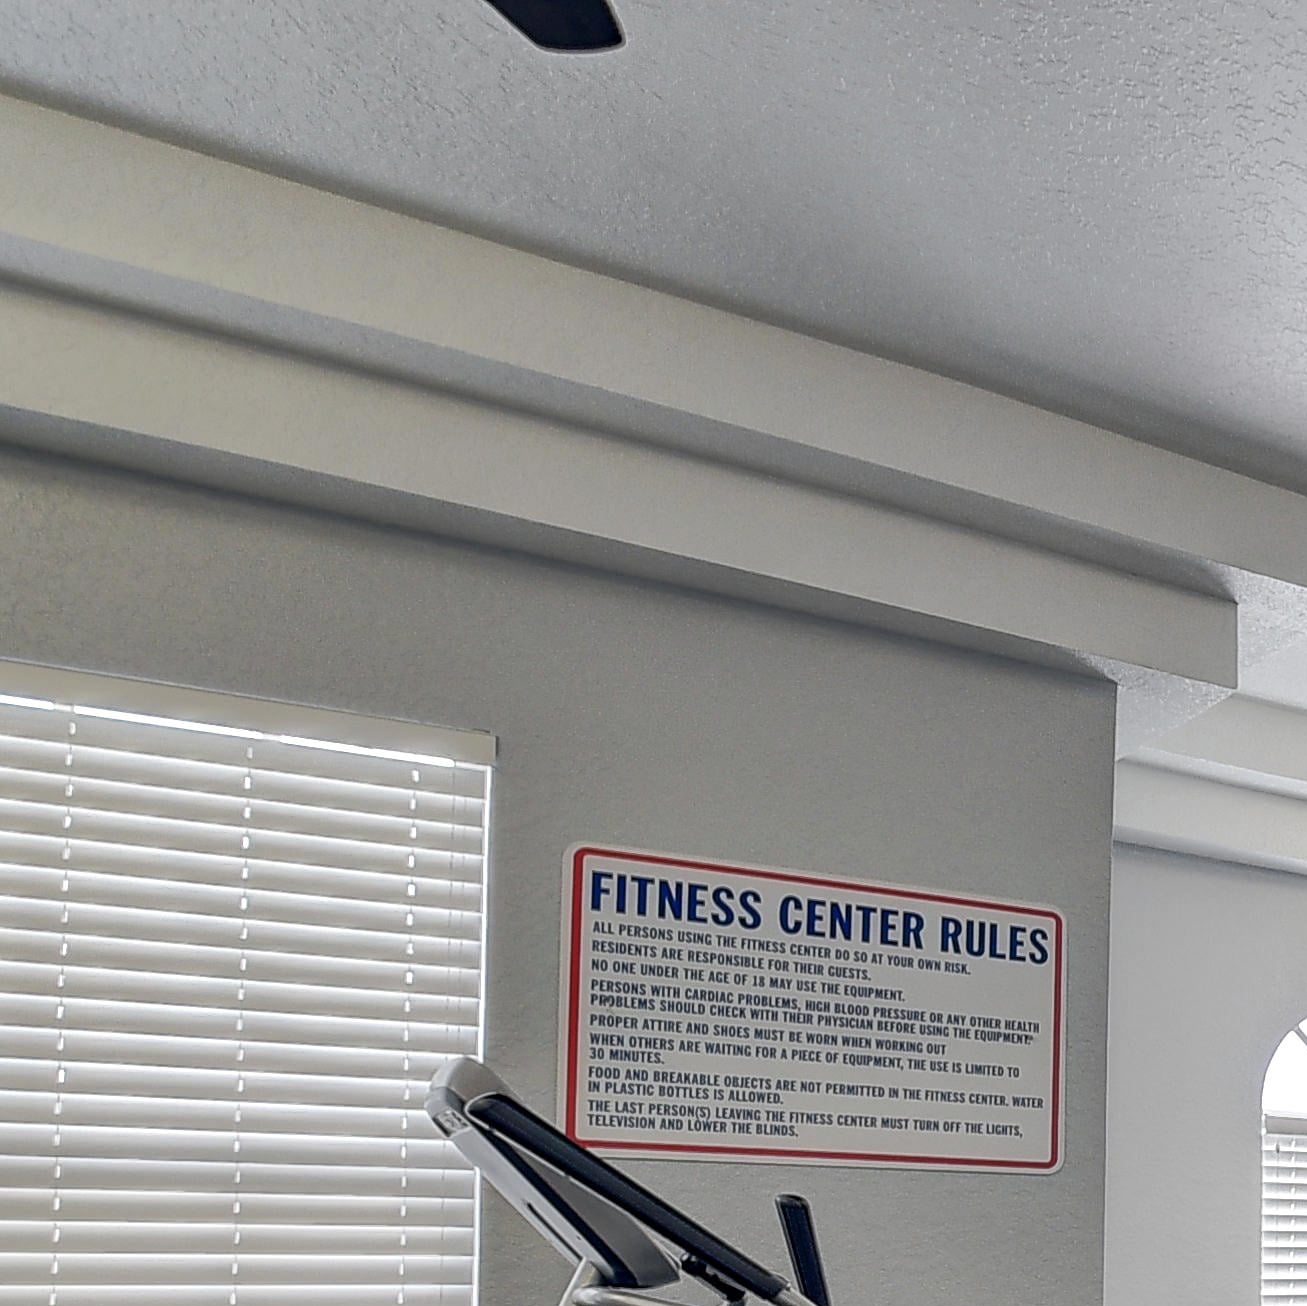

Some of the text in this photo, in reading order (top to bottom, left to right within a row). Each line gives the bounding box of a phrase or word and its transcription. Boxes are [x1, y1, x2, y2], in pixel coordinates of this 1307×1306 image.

[591, 870, 1049, 965] FITNESS CENTER RULES
[592, 940, 872, 981] RESIDENTS ARE RESPONSIBLE FOR THEIR GUESTS.
[593, 922, 971, 975] ALL PERSONS USING THE FITNESS CENTER DO SO AT YOUR OWN RISK.
[592, 959, 905, 1002] NO ONE UNDER THE AGE OF 18 MAY USE THE EQUIPMENT.
[591, 979, 1040, 1033] PERSONS WITH CARDIAC PROBLEMS, HIGH BLOOD PRESSURE OR ANY OTHER HEALTH
[591, 994, 656, 1011] PROBLEMS
[660, 1000, 706, 1015] SHOULD
[710, 1005, 747, 1019] CHECK
[750, 1009, 779, 1022] WITH
[783, 1012, 814, 1025] THEIR
[818, 1015, 874, 1031] PHYSICIAN
[878, 1021, 916, 1035] BEFORE
[920, 1024, 950, 1038] USING
[953, 1028, 971, 1040] THE
[590, 1014, 946, 1056] PROPER ATTIRE AND SHOES MUST BE WORN WHEN WORKING OUT
[590, 1033, 1020, 1078] WHEN OTHERS ARE WAITING FOR A PIECE OF EQUIPMENT, THE USE IS LIMITED TO
[590, 1047, 665, 1065] 30 MINUTES.
[589, 1066, 1044, 1109] FOOD AND BREAKABLE OBJECTS ARE NOT PERMITTED IN THE FITNESS CENTER. WATER
[589, 1081, 784, 1105] IN PLASTIC BOTTLES IS ALLOWED.
[588, 1100, 1023, 1138] THE LAST PERSON(S) LEAVING THE FITNESS CENTER MUST TURN OFF THE LIGHTS,
[588, 1114, 799, 1137] TELEVISION AND LOWER THE BLINDS.
